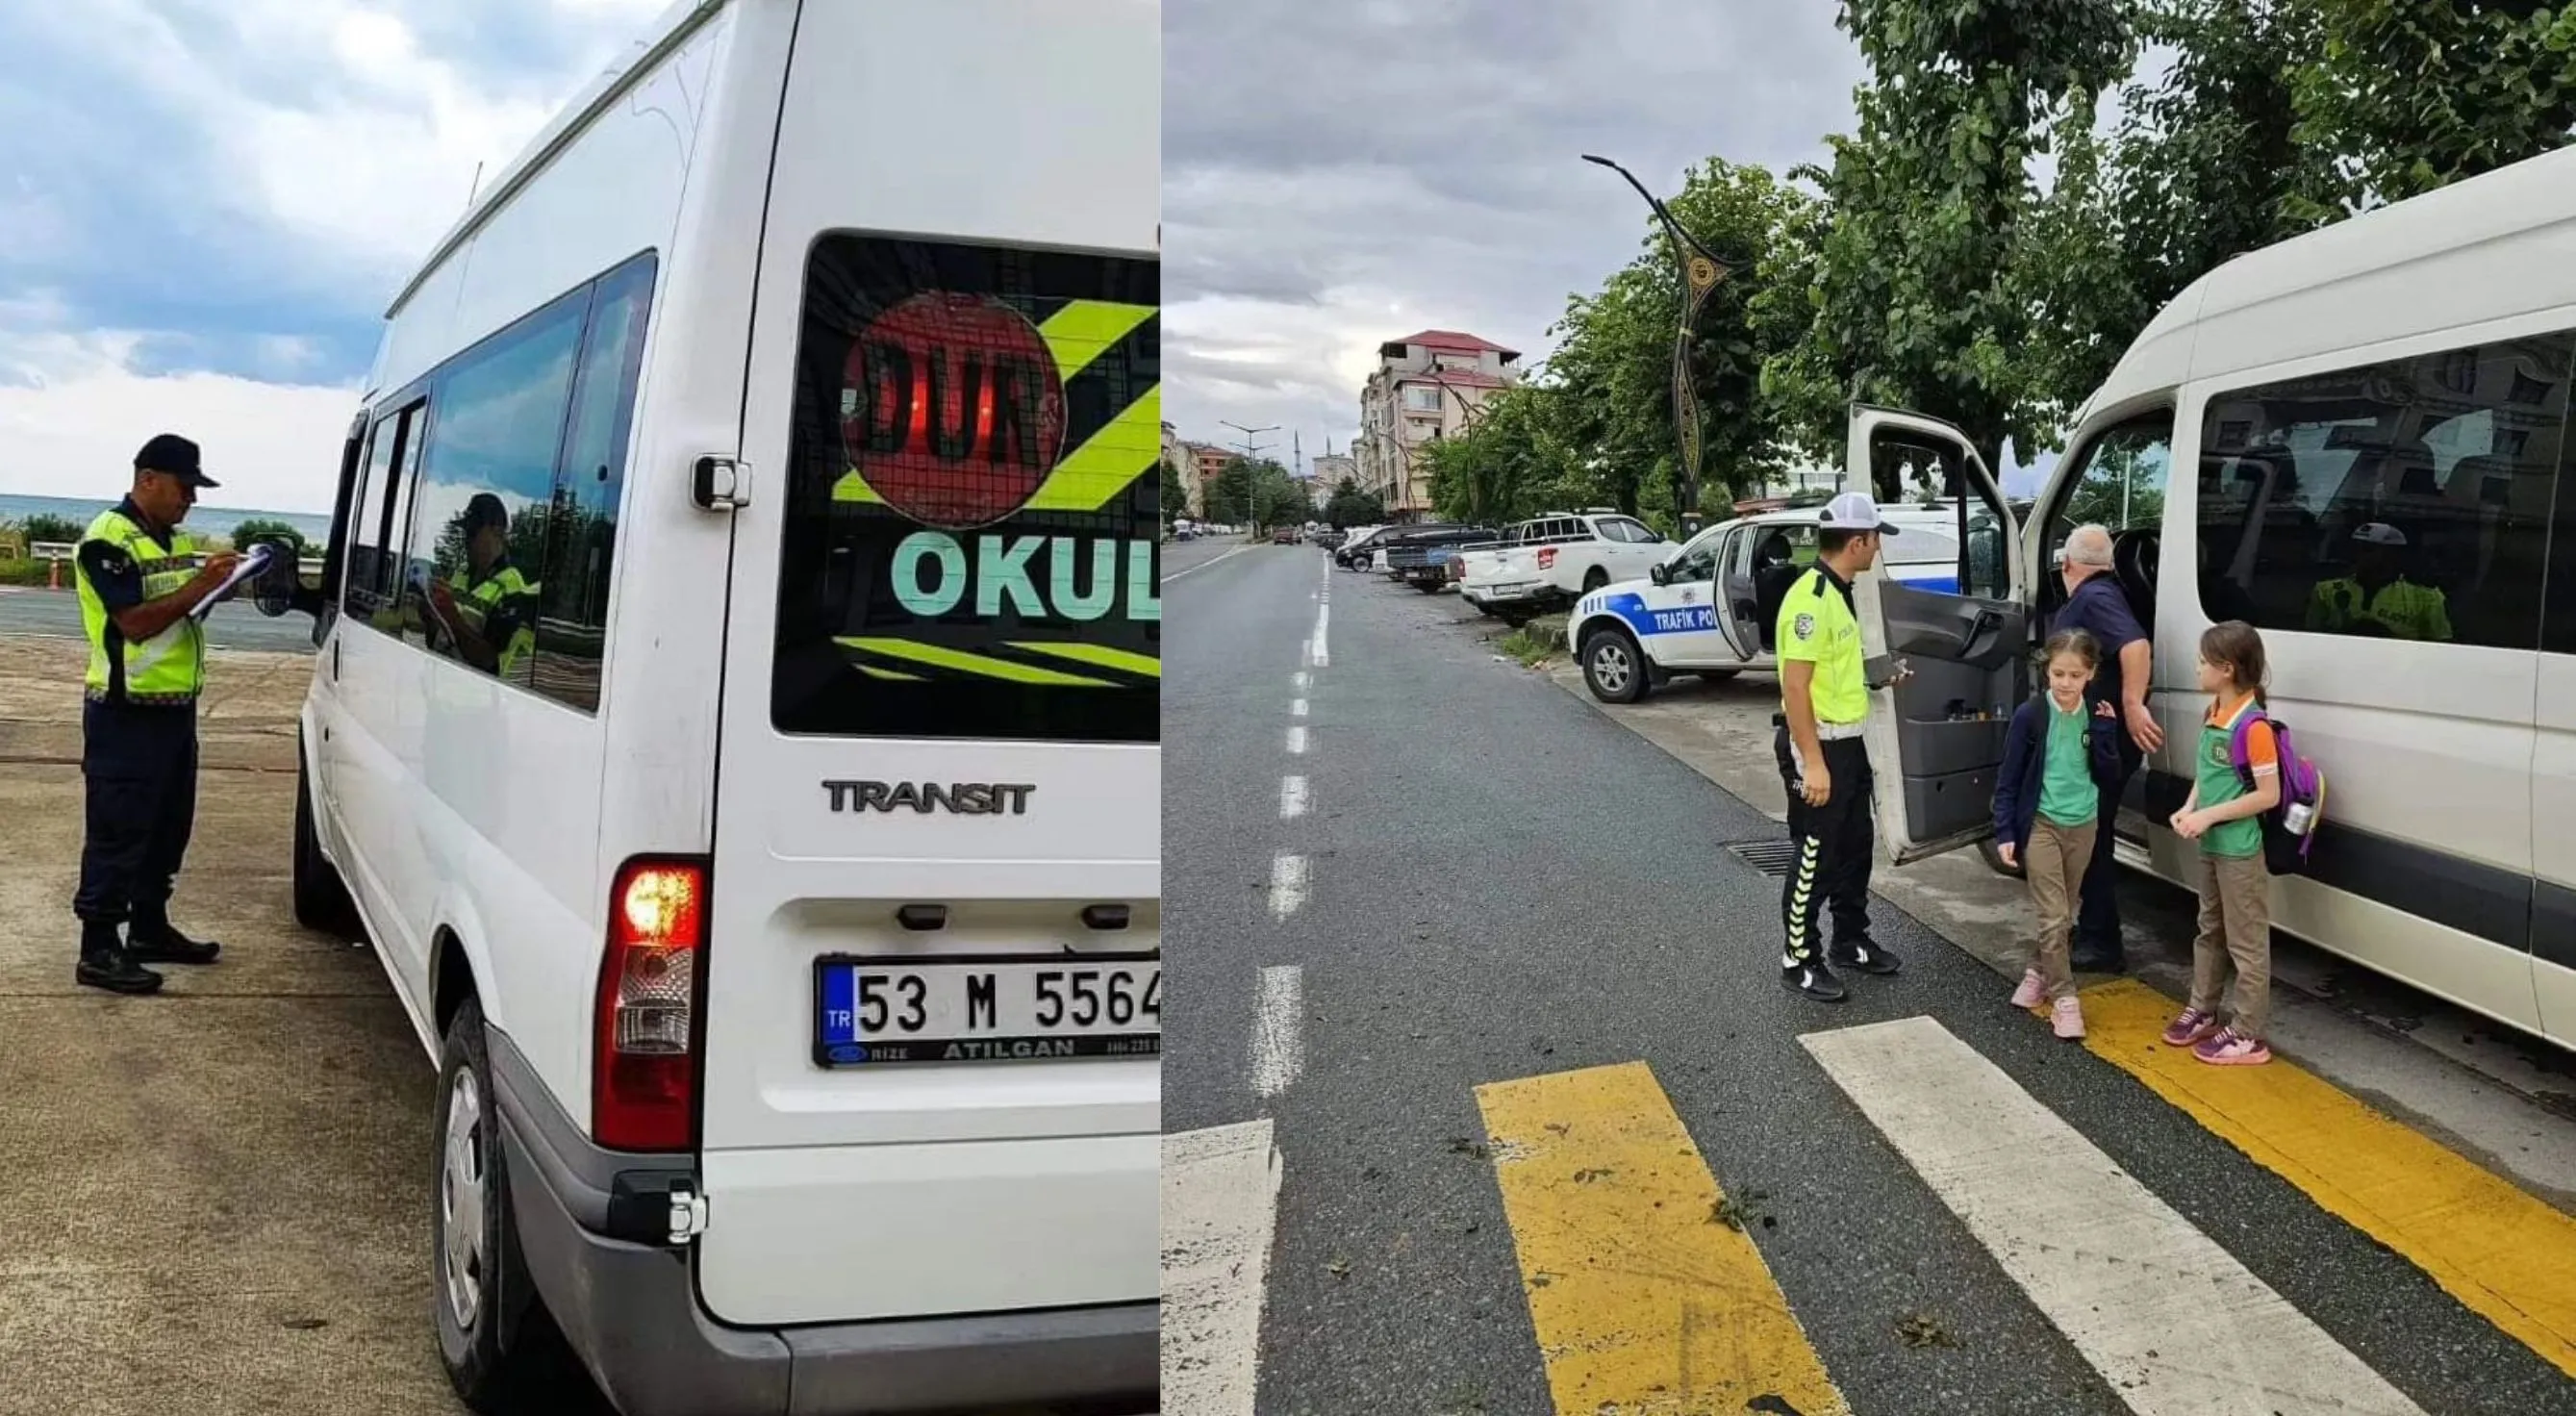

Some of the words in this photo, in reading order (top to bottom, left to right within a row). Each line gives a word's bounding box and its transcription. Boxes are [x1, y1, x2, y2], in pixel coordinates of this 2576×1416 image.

[861, 341, 1044, 468] DUR
[891, 530, 1160, 620] OKUL
[1654, 609, 1695, 630] TRAFİK
[821, 780, 1036, 814] TRANSIT
[827, 1009, 851, 1028] TR
[859, 974, 926, 1032] 53
[967, 973, 997, 1029] M
